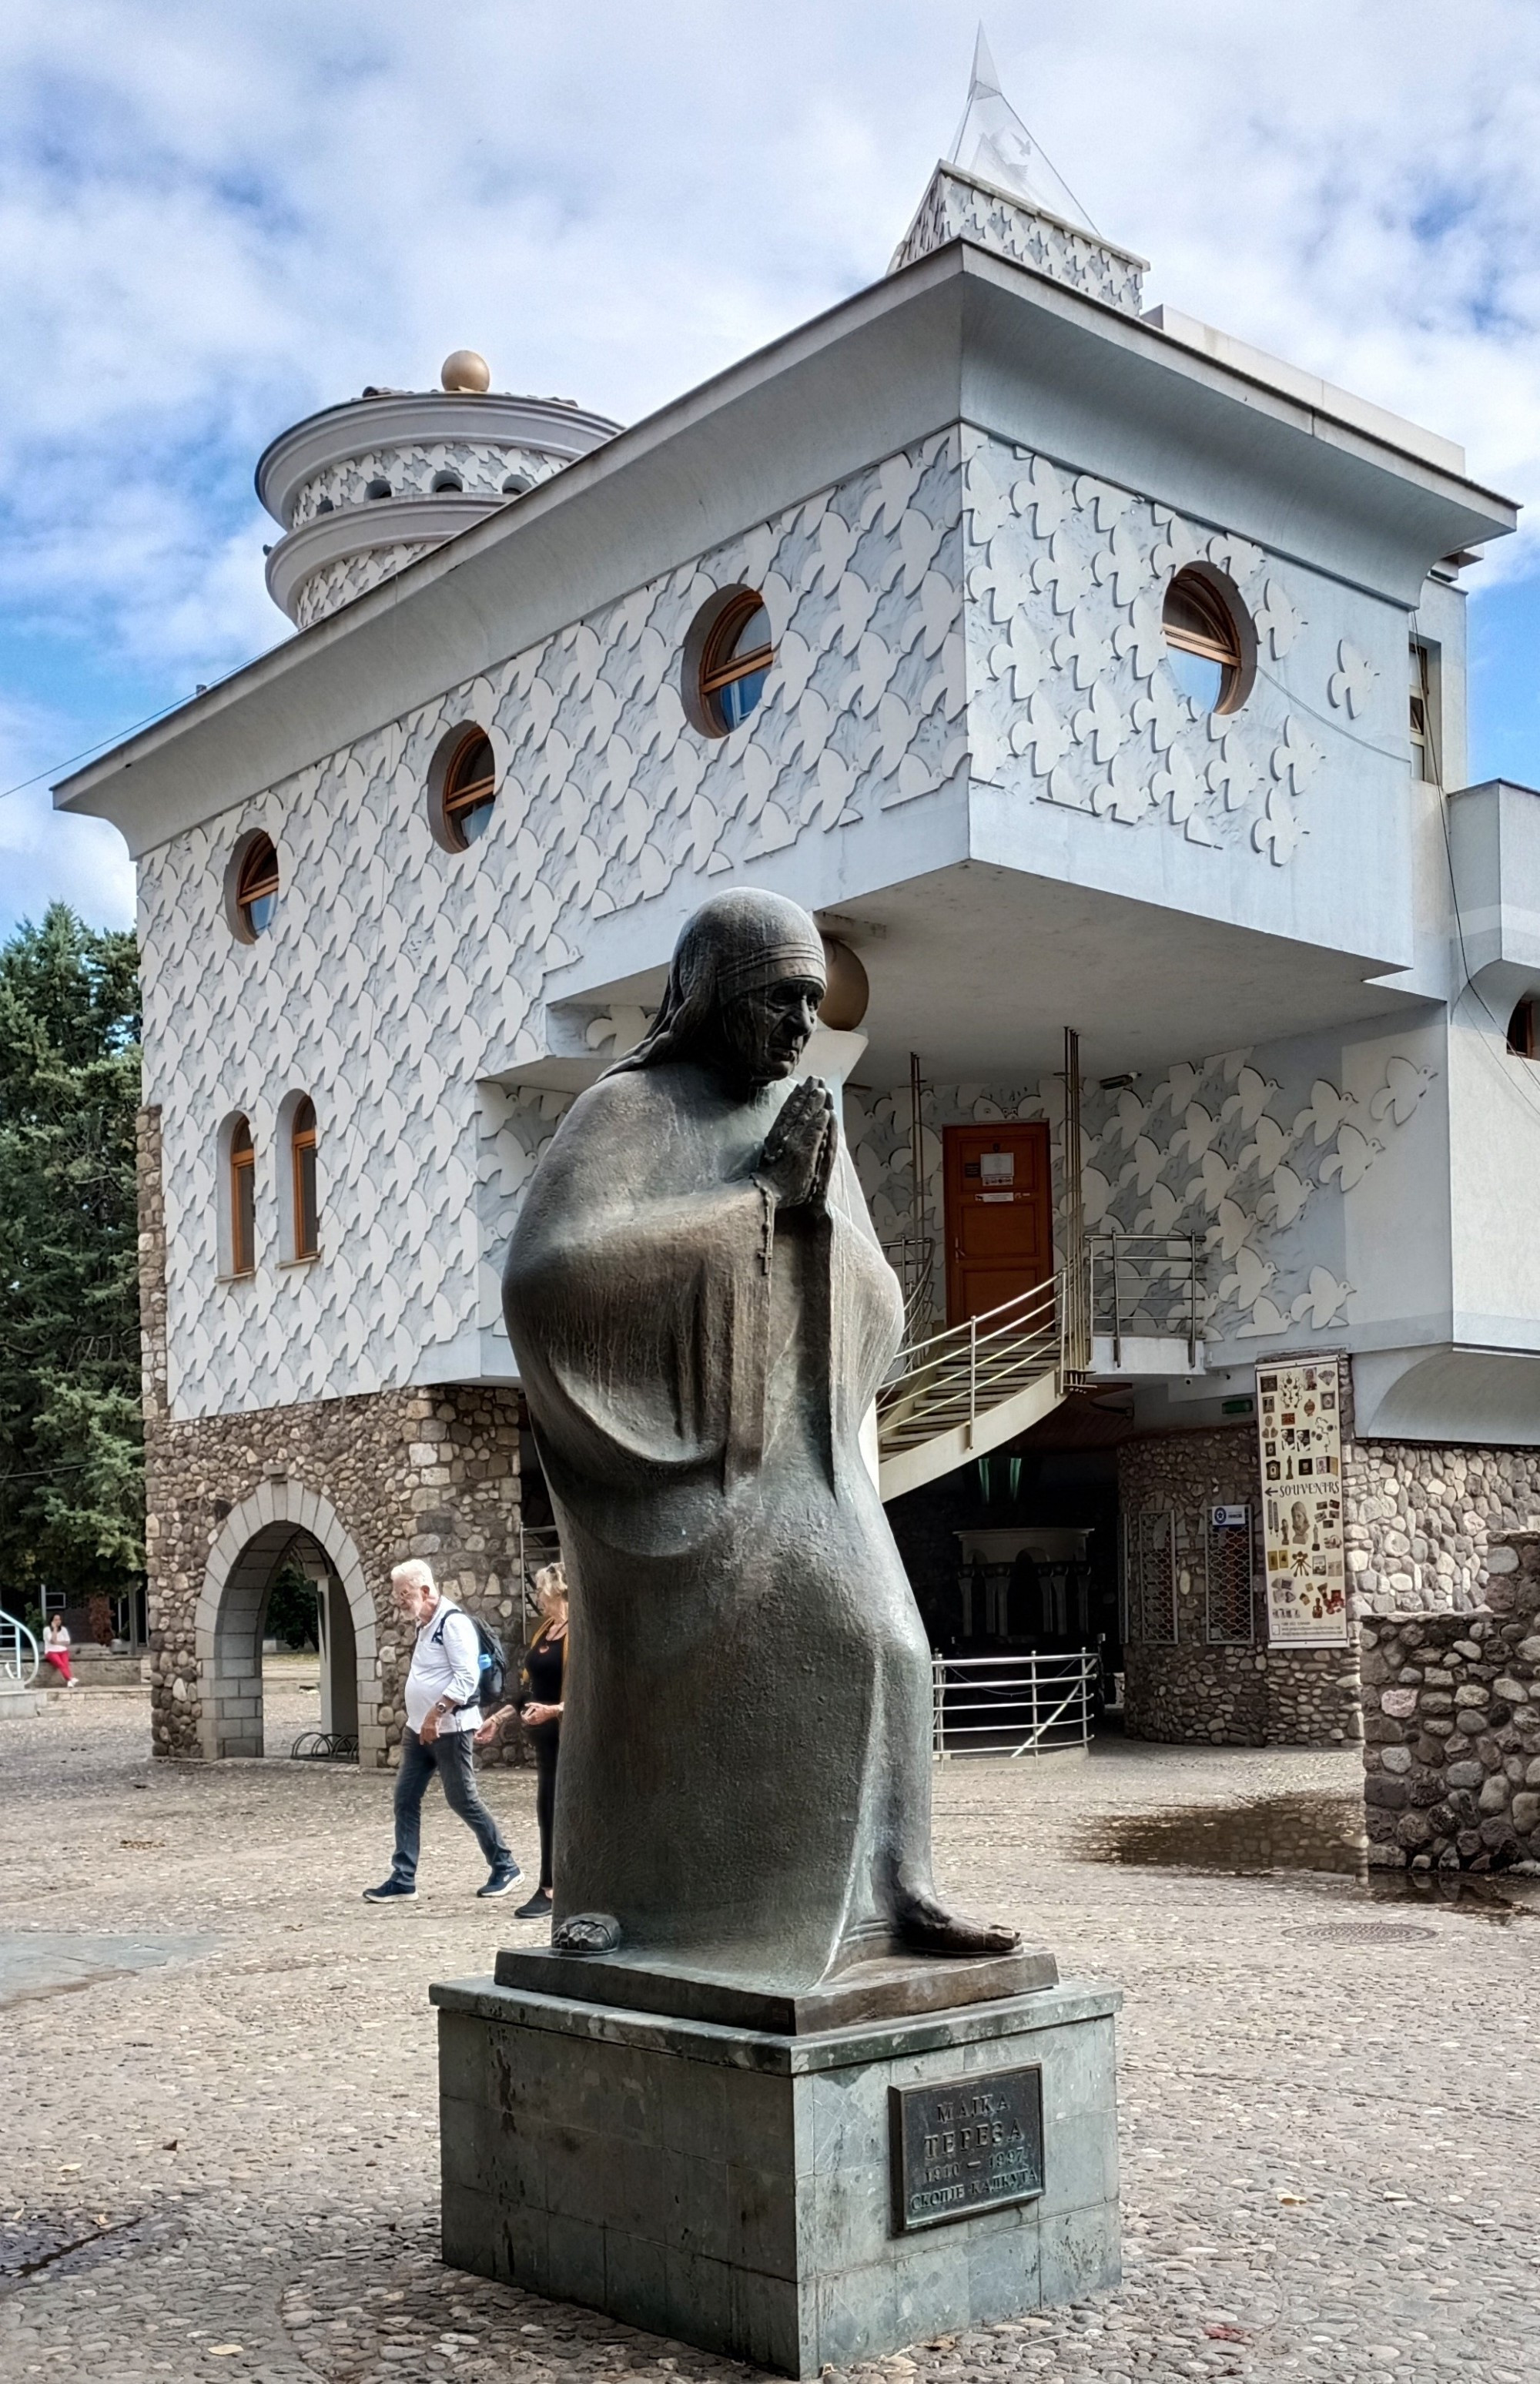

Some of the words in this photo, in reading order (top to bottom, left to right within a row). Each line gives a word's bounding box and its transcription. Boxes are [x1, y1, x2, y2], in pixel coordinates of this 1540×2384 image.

[1279, 1481, 1340, 1498] SOUVENIRS
[936, 2094, 1010, 2124] МАЈКА
[924, 2118, 1024, 2160] ТЕРЕЗА
[925, 2162, 959, 2182] 1910
[989, 2146, 1024, 2169] 1997
[911, 2184, 965, 2211] СКОПЈЕ
